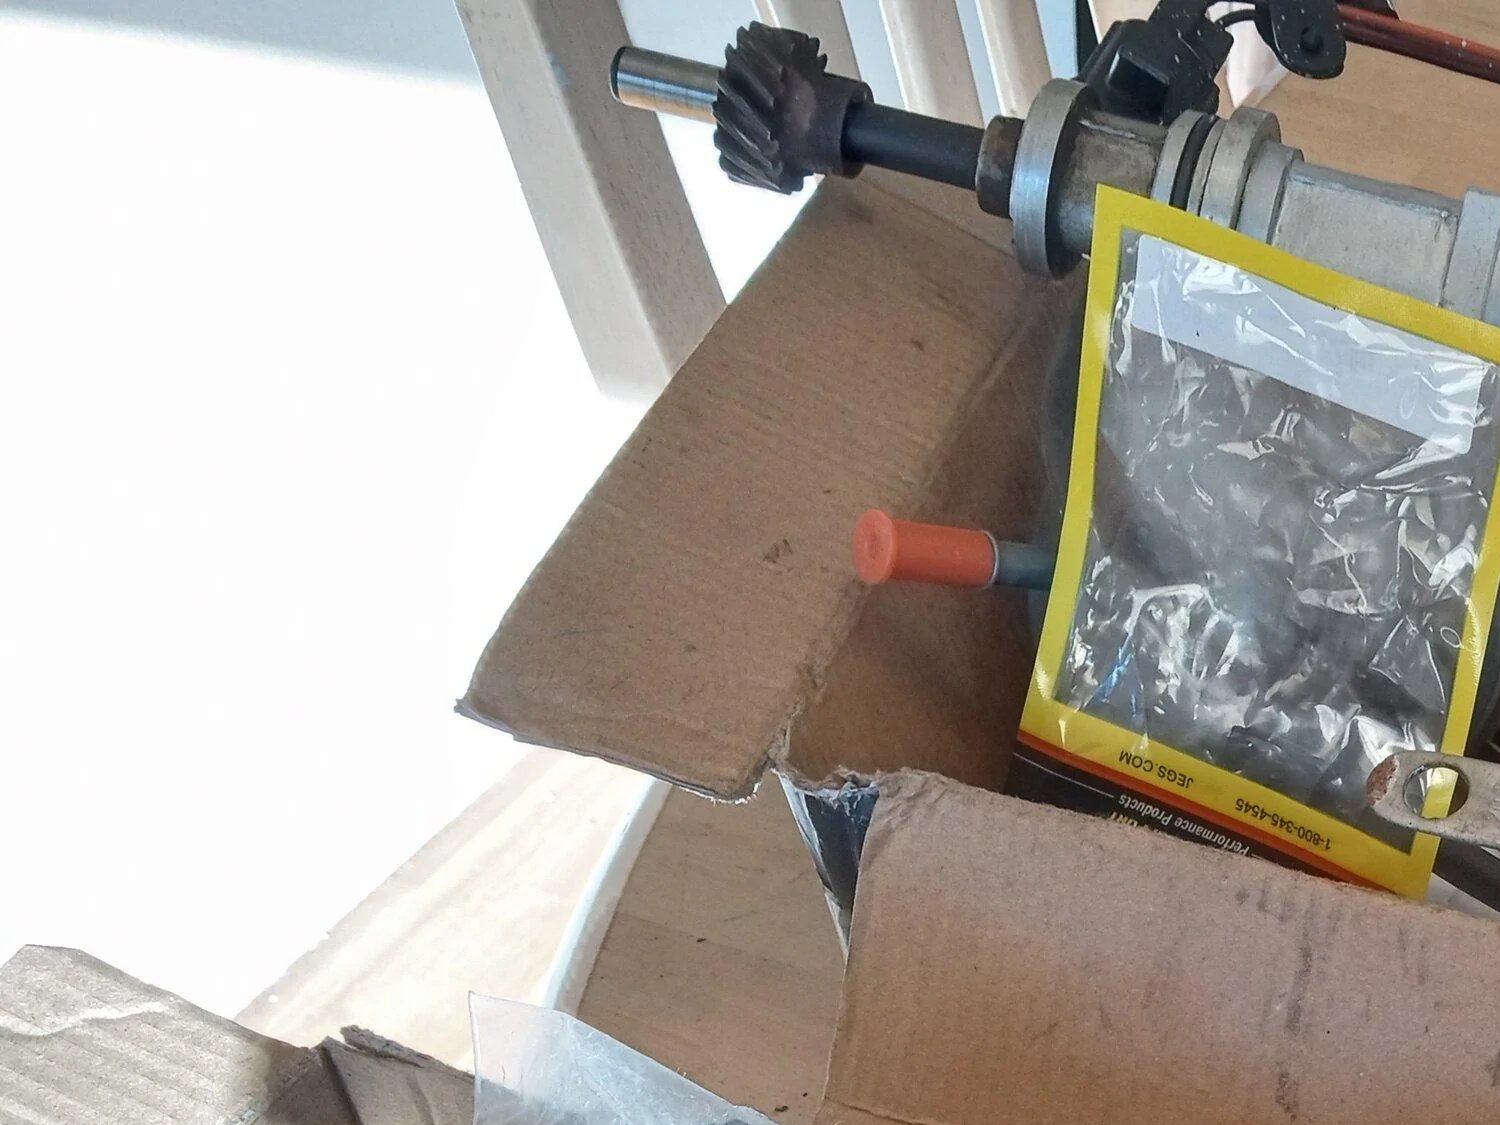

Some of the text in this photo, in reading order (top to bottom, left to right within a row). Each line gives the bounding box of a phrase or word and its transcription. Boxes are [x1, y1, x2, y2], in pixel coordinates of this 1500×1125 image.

[1118, 750, 1194, 789] JEGS.COM
[1118, 793, 1173, 826] Products
[1235, 798, 1332, 850] 1-800-345-4545
[1173, 816, 1250, 856] Performance
